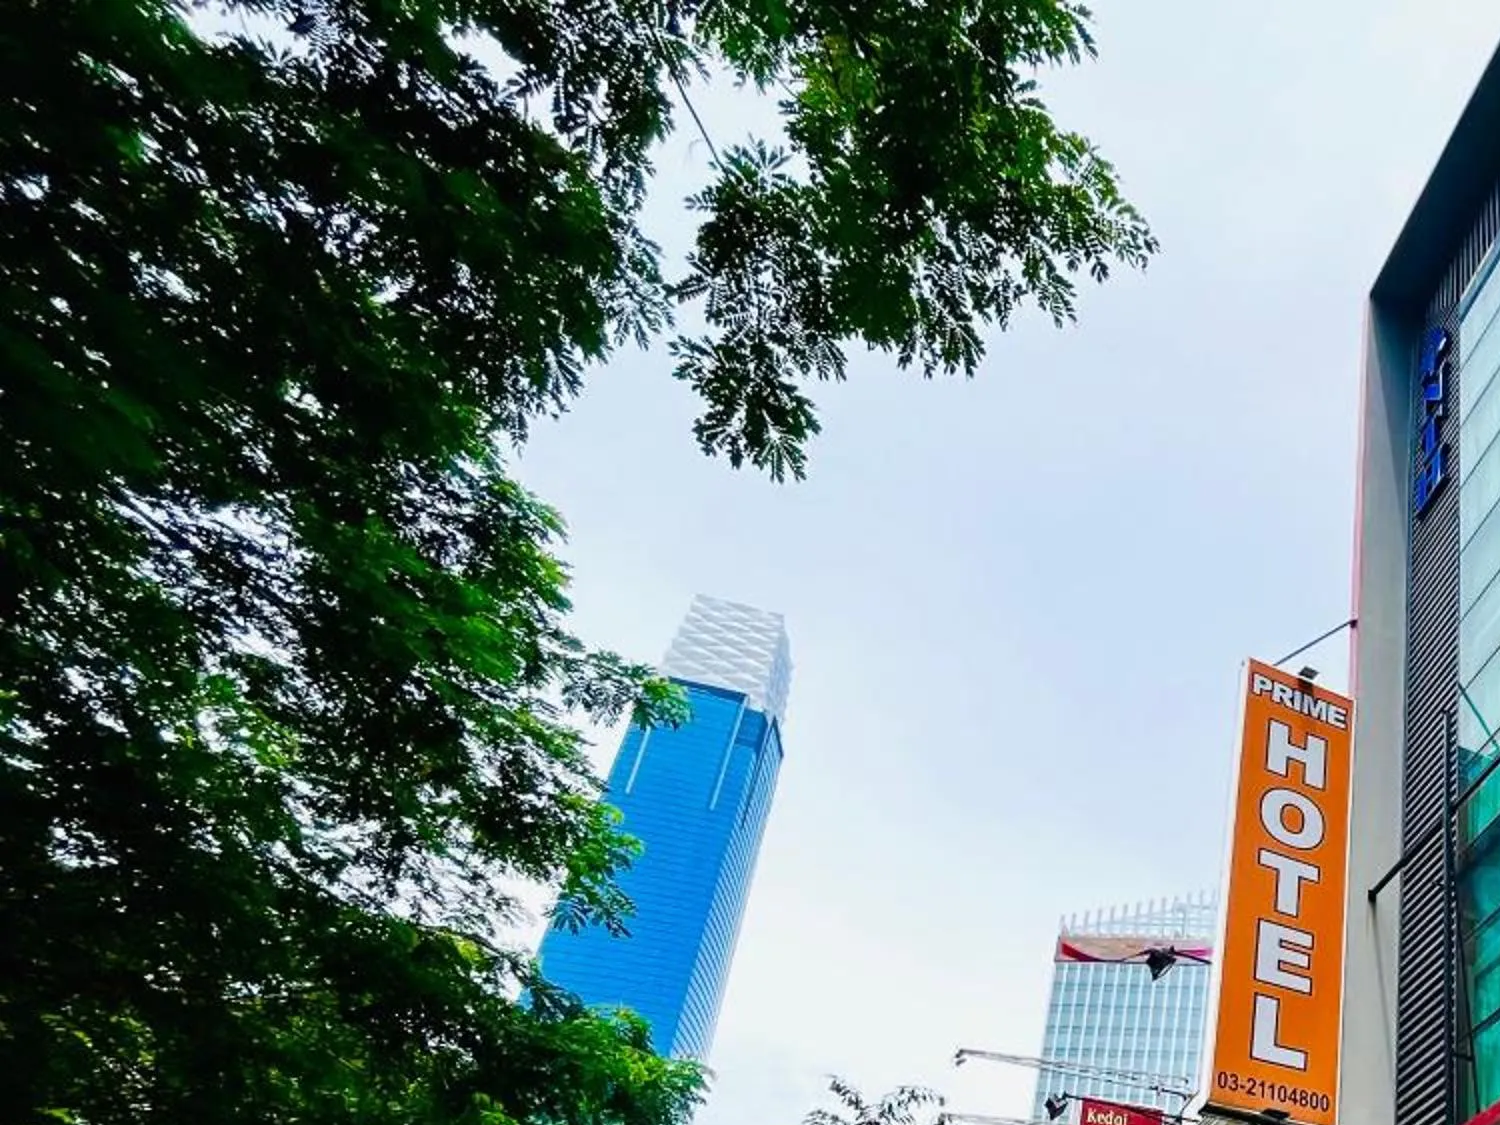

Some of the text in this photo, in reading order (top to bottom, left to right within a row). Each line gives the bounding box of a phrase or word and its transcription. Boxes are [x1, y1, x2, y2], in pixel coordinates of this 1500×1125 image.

[1252, 672, 1347, 730] PRIME
[1249, 717, 1328, 1072] HOTEL
[1217, 1071, 1330, 1112] 03-21104800
